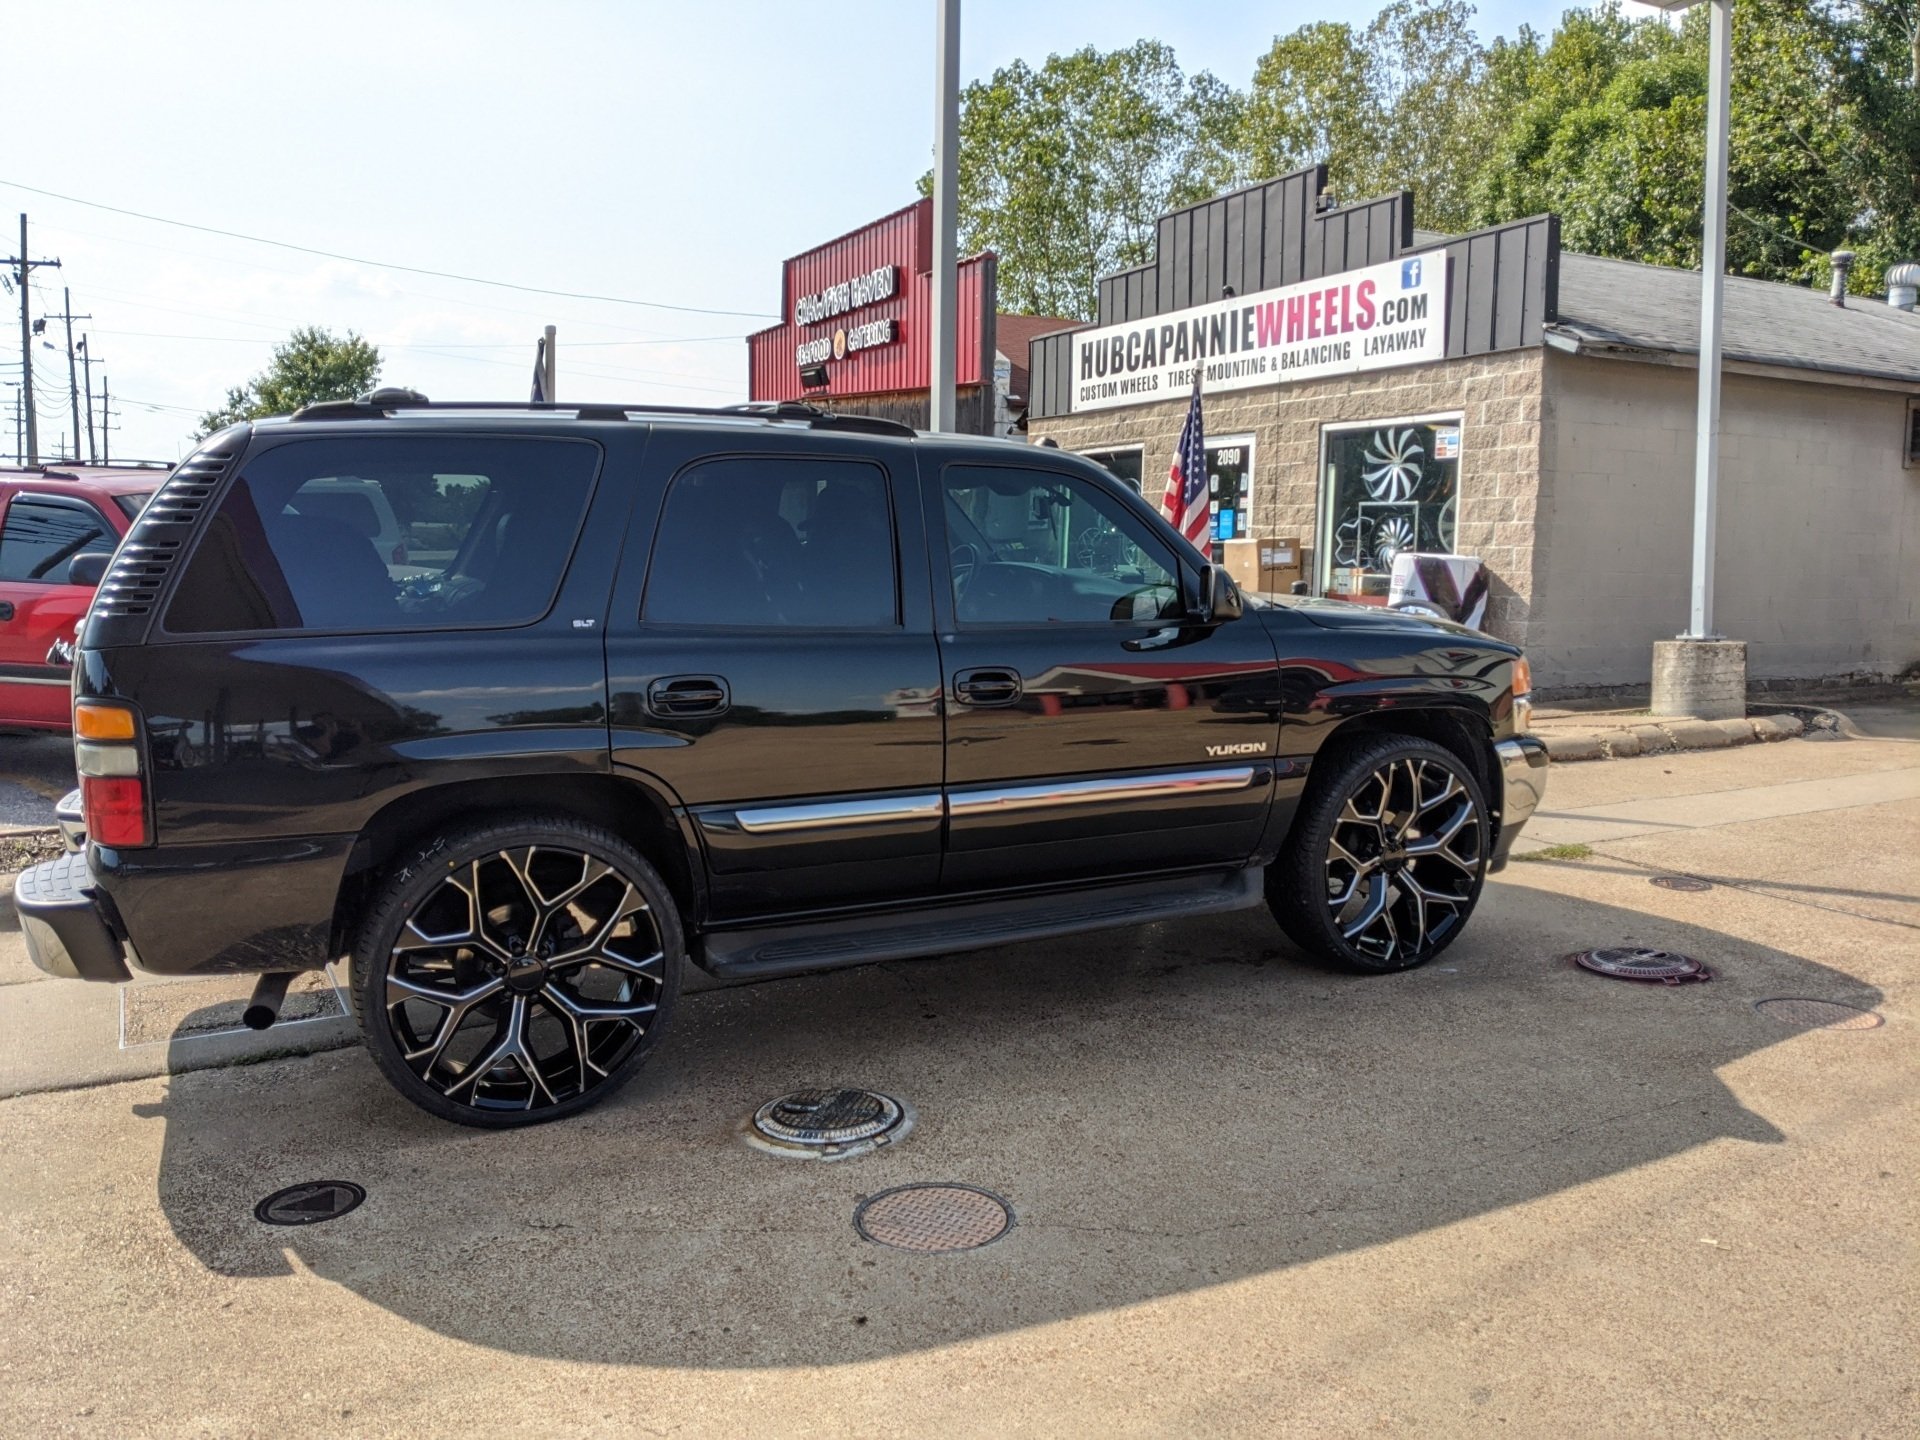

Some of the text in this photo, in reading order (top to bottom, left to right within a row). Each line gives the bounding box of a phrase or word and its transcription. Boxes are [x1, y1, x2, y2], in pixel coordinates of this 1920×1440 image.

[795, 264, 893, 327] CRAWFISH HAVEN
[796, 318, 890, 366] SEAFOOD CATERING
[1080, 327, 1426, 402] CUSTOM WHEELS TIRES MOUNTING & BALANCING LAYAWAY
[1217, 447, 1240, 466] 2090
[572, 619, 595, 628] SLT
[1205, 741, 1267, 756] YUKON
